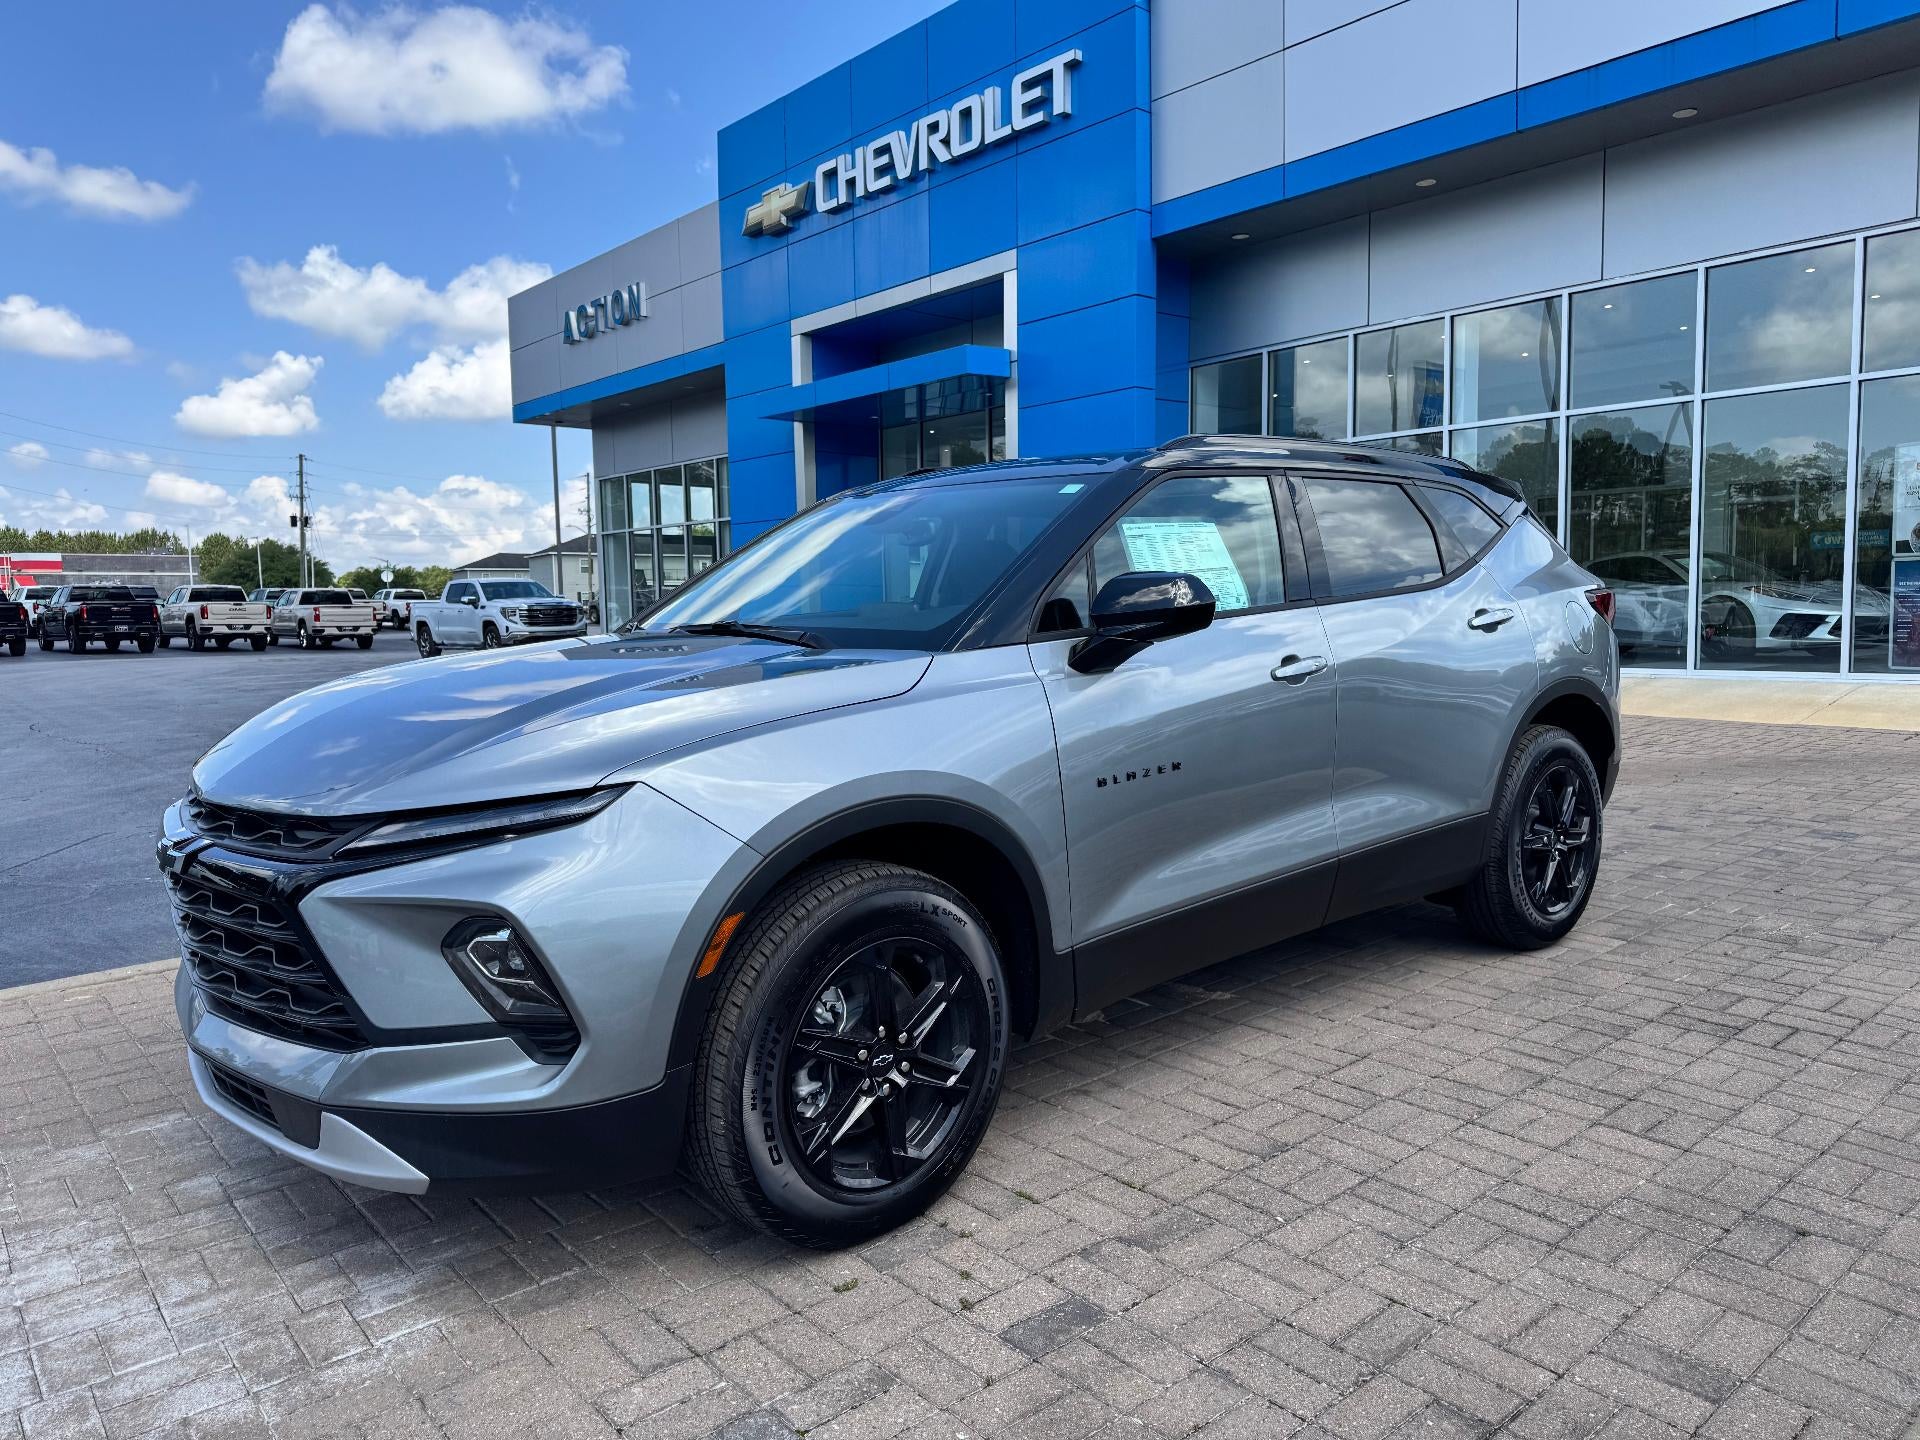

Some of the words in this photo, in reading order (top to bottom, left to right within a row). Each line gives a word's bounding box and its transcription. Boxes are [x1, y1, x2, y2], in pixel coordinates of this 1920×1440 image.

[815, 48, 1082, 213] CHEVROLET
[563, 282, 647, 345] ACTION
[1097, 761, 1182, 788] BLAZER
[942, 907, 968, 928] SPORT
